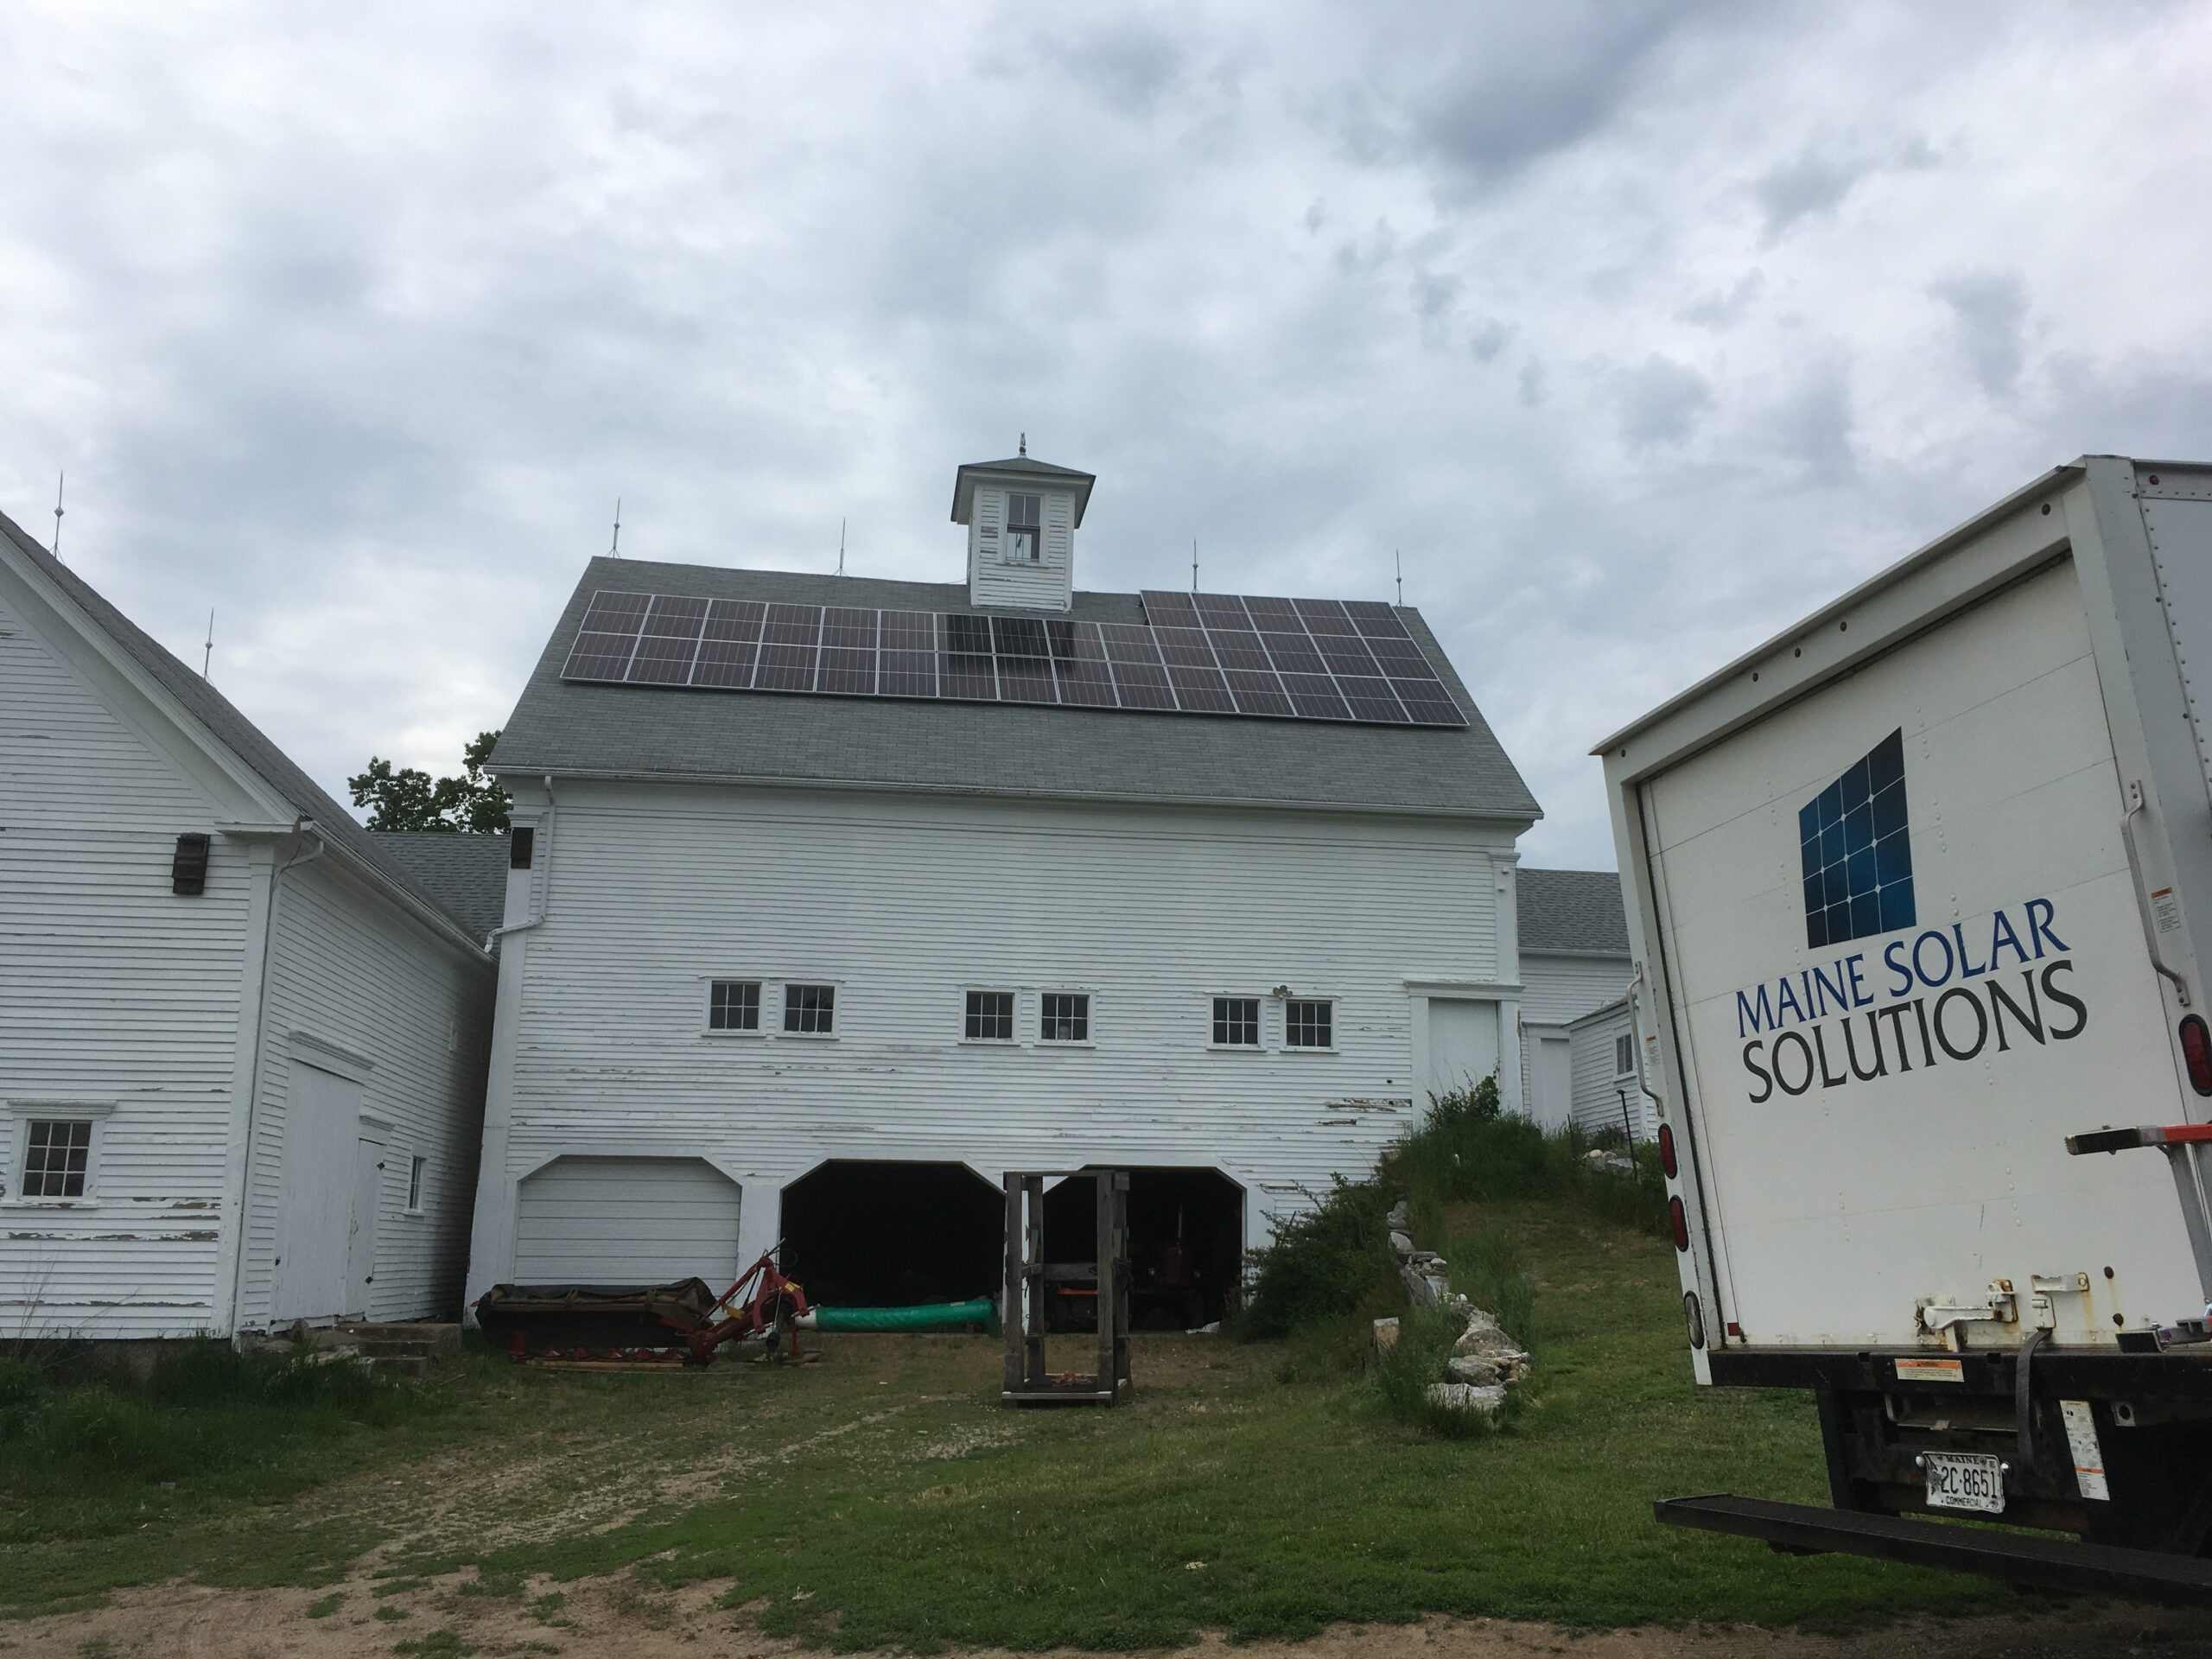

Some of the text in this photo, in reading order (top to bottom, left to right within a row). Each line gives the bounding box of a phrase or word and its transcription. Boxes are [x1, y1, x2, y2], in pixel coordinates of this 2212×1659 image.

[1736, 897, 2071, 1038] MAINE SOLAR
[1743, 959, 2088, 1104] SOLUTIONS
[1945, 1455, 1980, 1465] MAINE
[1946, 1496, 1981, 1507] COMMERCIAL
